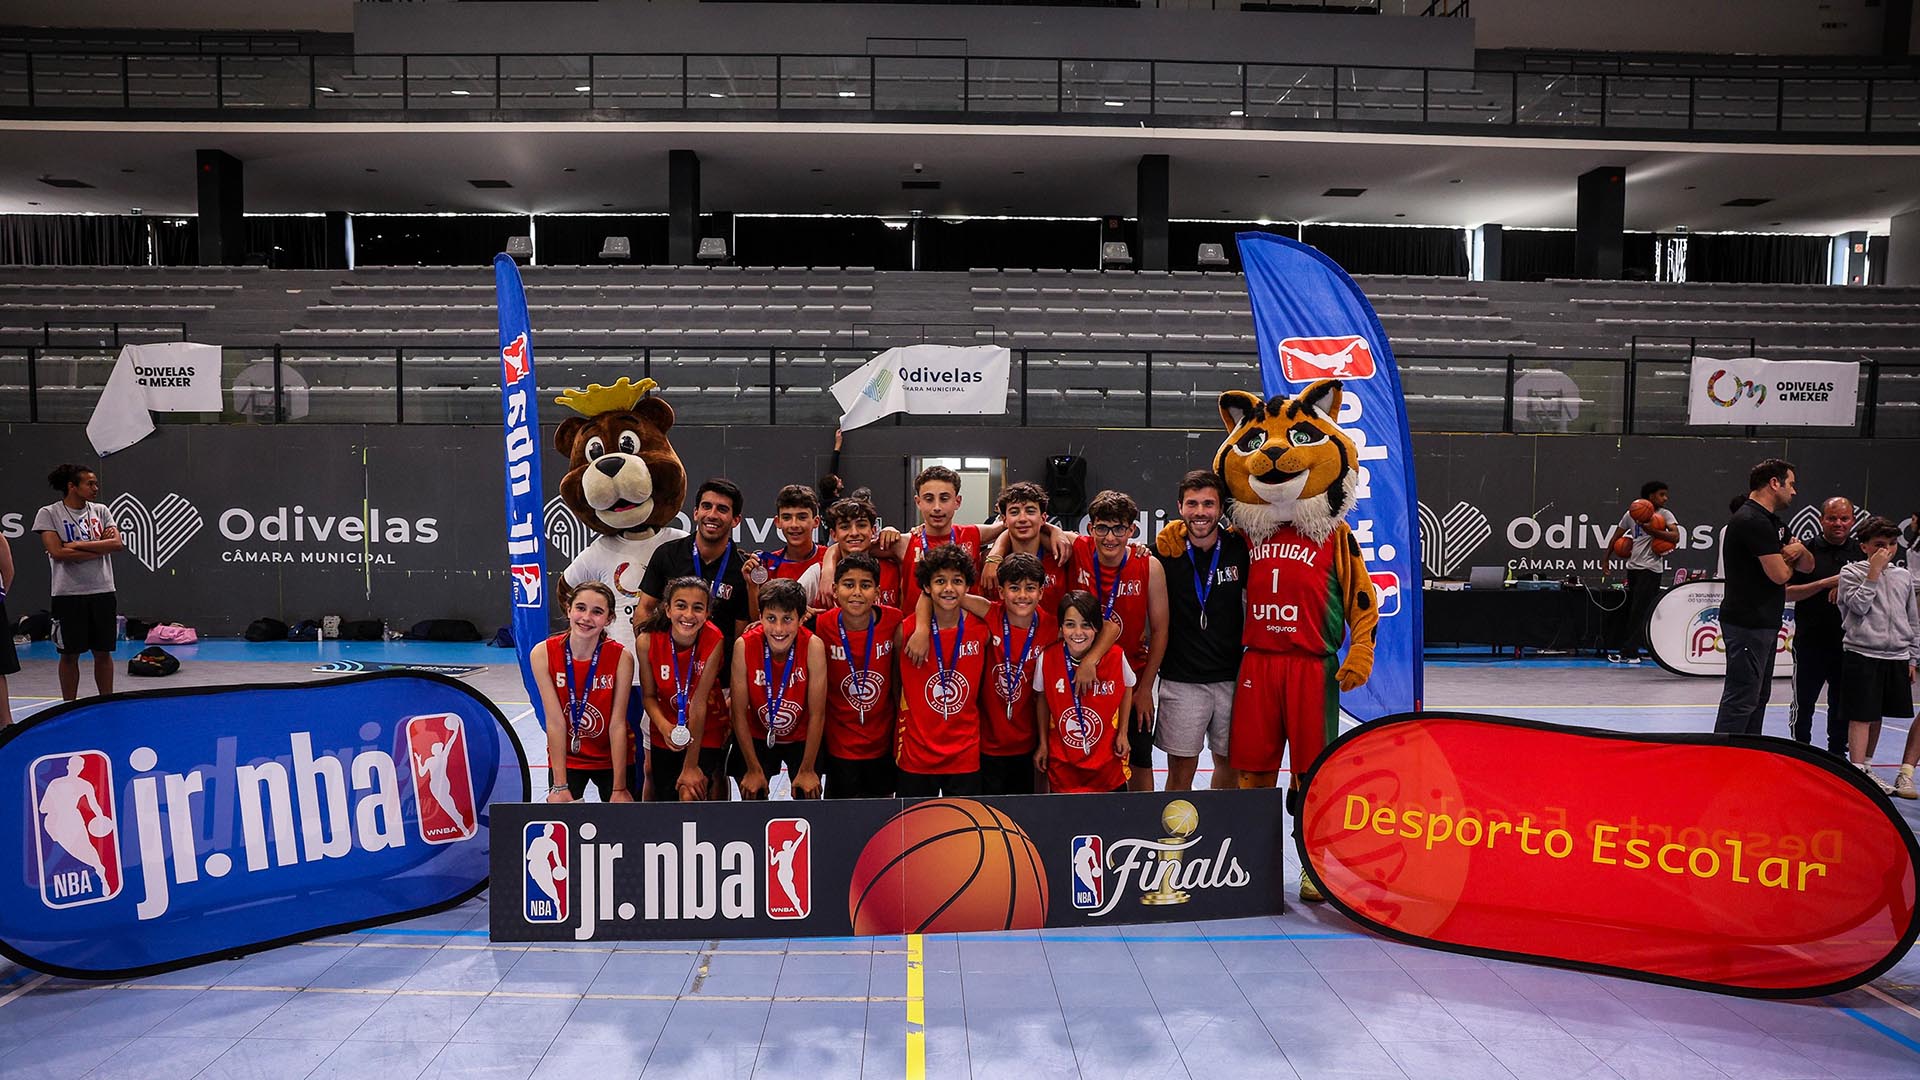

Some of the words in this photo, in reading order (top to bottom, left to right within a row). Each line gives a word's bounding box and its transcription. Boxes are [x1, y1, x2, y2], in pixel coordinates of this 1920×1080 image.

[134, 366, 195, 377] ODIVELAS
[899, 367, 983, 383] Odivelas
[138, 378, 147, 386] a
[150, 377, 191, 387] MEXER
[926, 385, 966, 393] MUNICIPAL
[1776, 381, 1834, 392] ODIVELAS
[1779, 393, 1787, 402] a
[1789, 392, 1829, 402] MEXER
[218, 505, 439, 544] Odivelas
[1506, 513, 1714, 550] Odivas
[221, 549, 295, 563] CÂMARA
[301, 551, 396, 565] MUNICIPAL
[1249, 543, 1317, 567] PORTUGAL
[1507, 556, 1576, 570] CÂMARA
[1583, 559, 1673, 570] MUNIL
[1216, 568, 1226, 585] jr.
[1271, 568, 1279, 593] 1
[1116, 580, 1127, 597] jr.
[1253, 603, 1299, 622] una
[1266, 624, 1297, 634] seguros
[830, 644, 847, 660] 10
[875, 643, 885, 660] jr.
[958, 642, 967, 659] jr.
[556, 671, 566, 688] 5
[660, 664, 670, 681] 8
[592, 675, 600, 691] jr.
[1055, 678, 1065, 693] 4
[1093, 681, 1101, 697] jr.
[426, 826, 458, 836] WNBA
[1343, 794, 1573, 858] Desporto
[1592, 824, 1826, 891] Escolar
[53, 869, 93, 899] NBA
[1087, 835, 1251, 917] Finals
[1077, 891, 1092, 904] NBA
[530, 900, 552, 917] NBA
